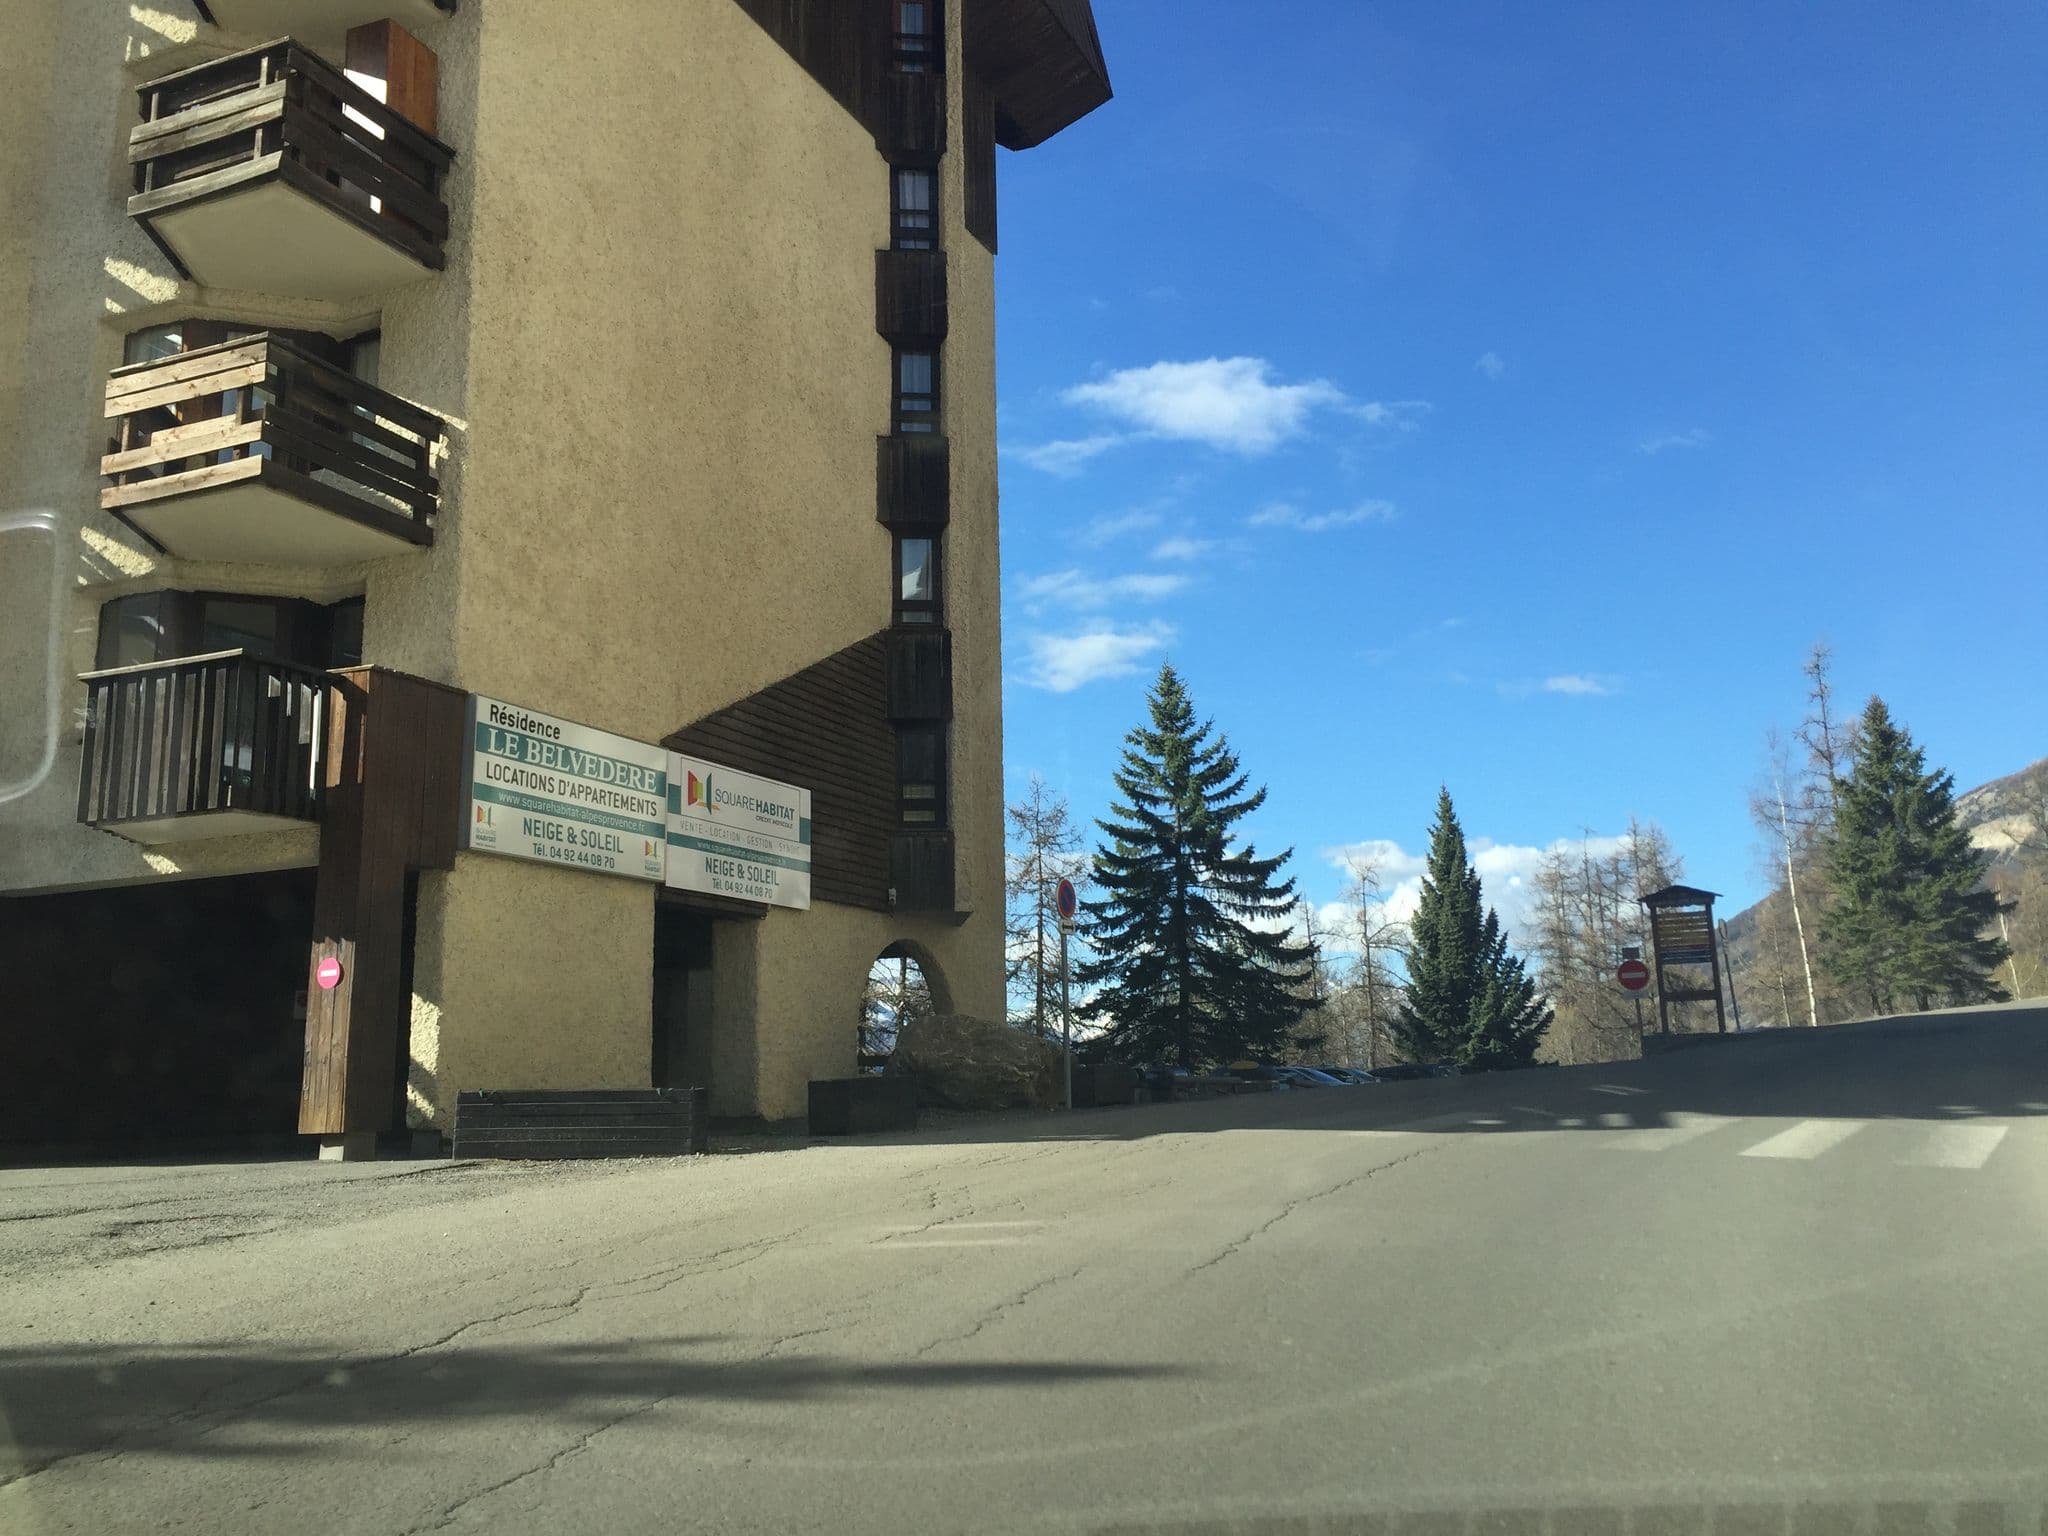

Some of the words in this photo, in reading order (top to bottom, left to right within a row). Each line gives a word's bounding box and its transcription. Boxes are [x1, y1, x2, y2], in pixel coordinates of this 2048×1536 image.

[490, 704, 561, 740] Résidence
[488, 728, 520, 759] LE
[525, 738, 657, 793] BELVEDERE
[486, 761, 555, 793] LOCATIONS
[558, 779, 657, 817] D'APPARTEMENTS
[523, 817, 564, 842] NEIGE
[567, 826, 577, 844] &
[581, 829, 624, 853] SOLEIL
[533, 843, 548, 857] Tél.
[550, 847, 561, 858] 04
[564, 850, 575, 862] 92
[577, 853, 589, 864] 44
[590, 855, 601, 867] 08
[604, 857, 615, 869] 70
[705, 857, 735, 878] NEIGE
[737, 864, 745, 879] &
[747, 865, 780, 886] SOLEIL
[725, 880, 734, 892] 04
[735, 882, 743, 893] 92
[745, 884, 754, 896] 44
